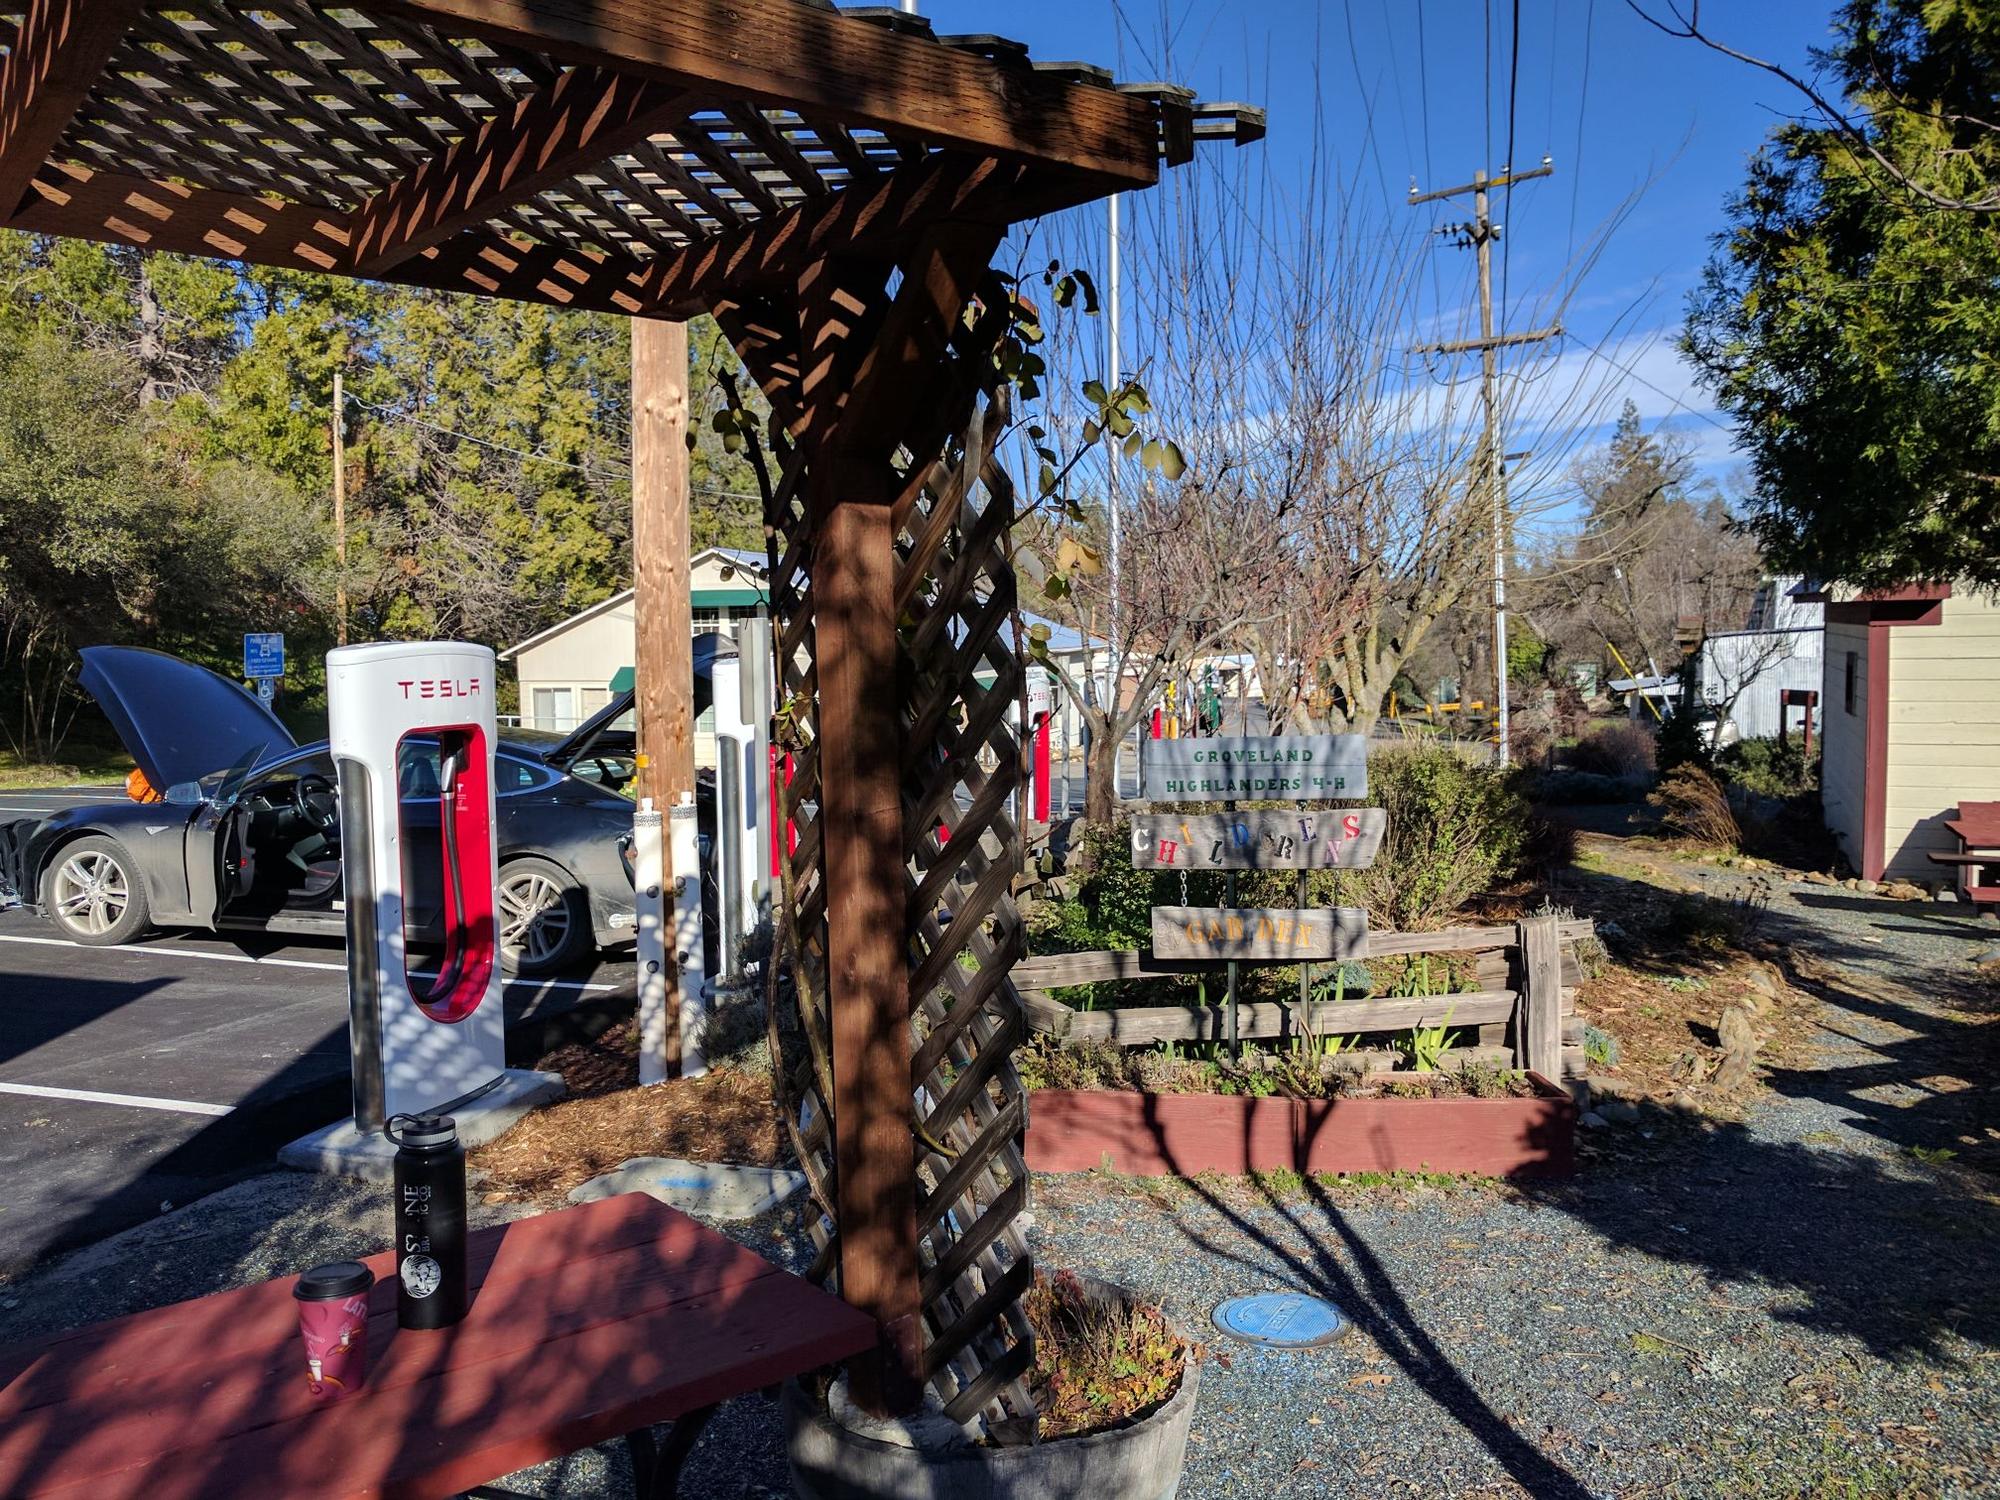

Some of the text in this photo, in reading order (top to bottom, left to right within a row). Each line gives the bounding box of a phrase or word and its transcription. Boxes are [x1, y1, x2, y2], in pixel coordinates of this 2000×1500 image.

[397, 679, 480, 699] TESLA
[1194, 750, 1313, 762] GROVELAND
[1166, 777, 1346, 793] HIGHLANDERS 4-H
[1133, 815, 1361, 865] CHILDRENS
[1185, 914, 1313, 948] GARDEN
